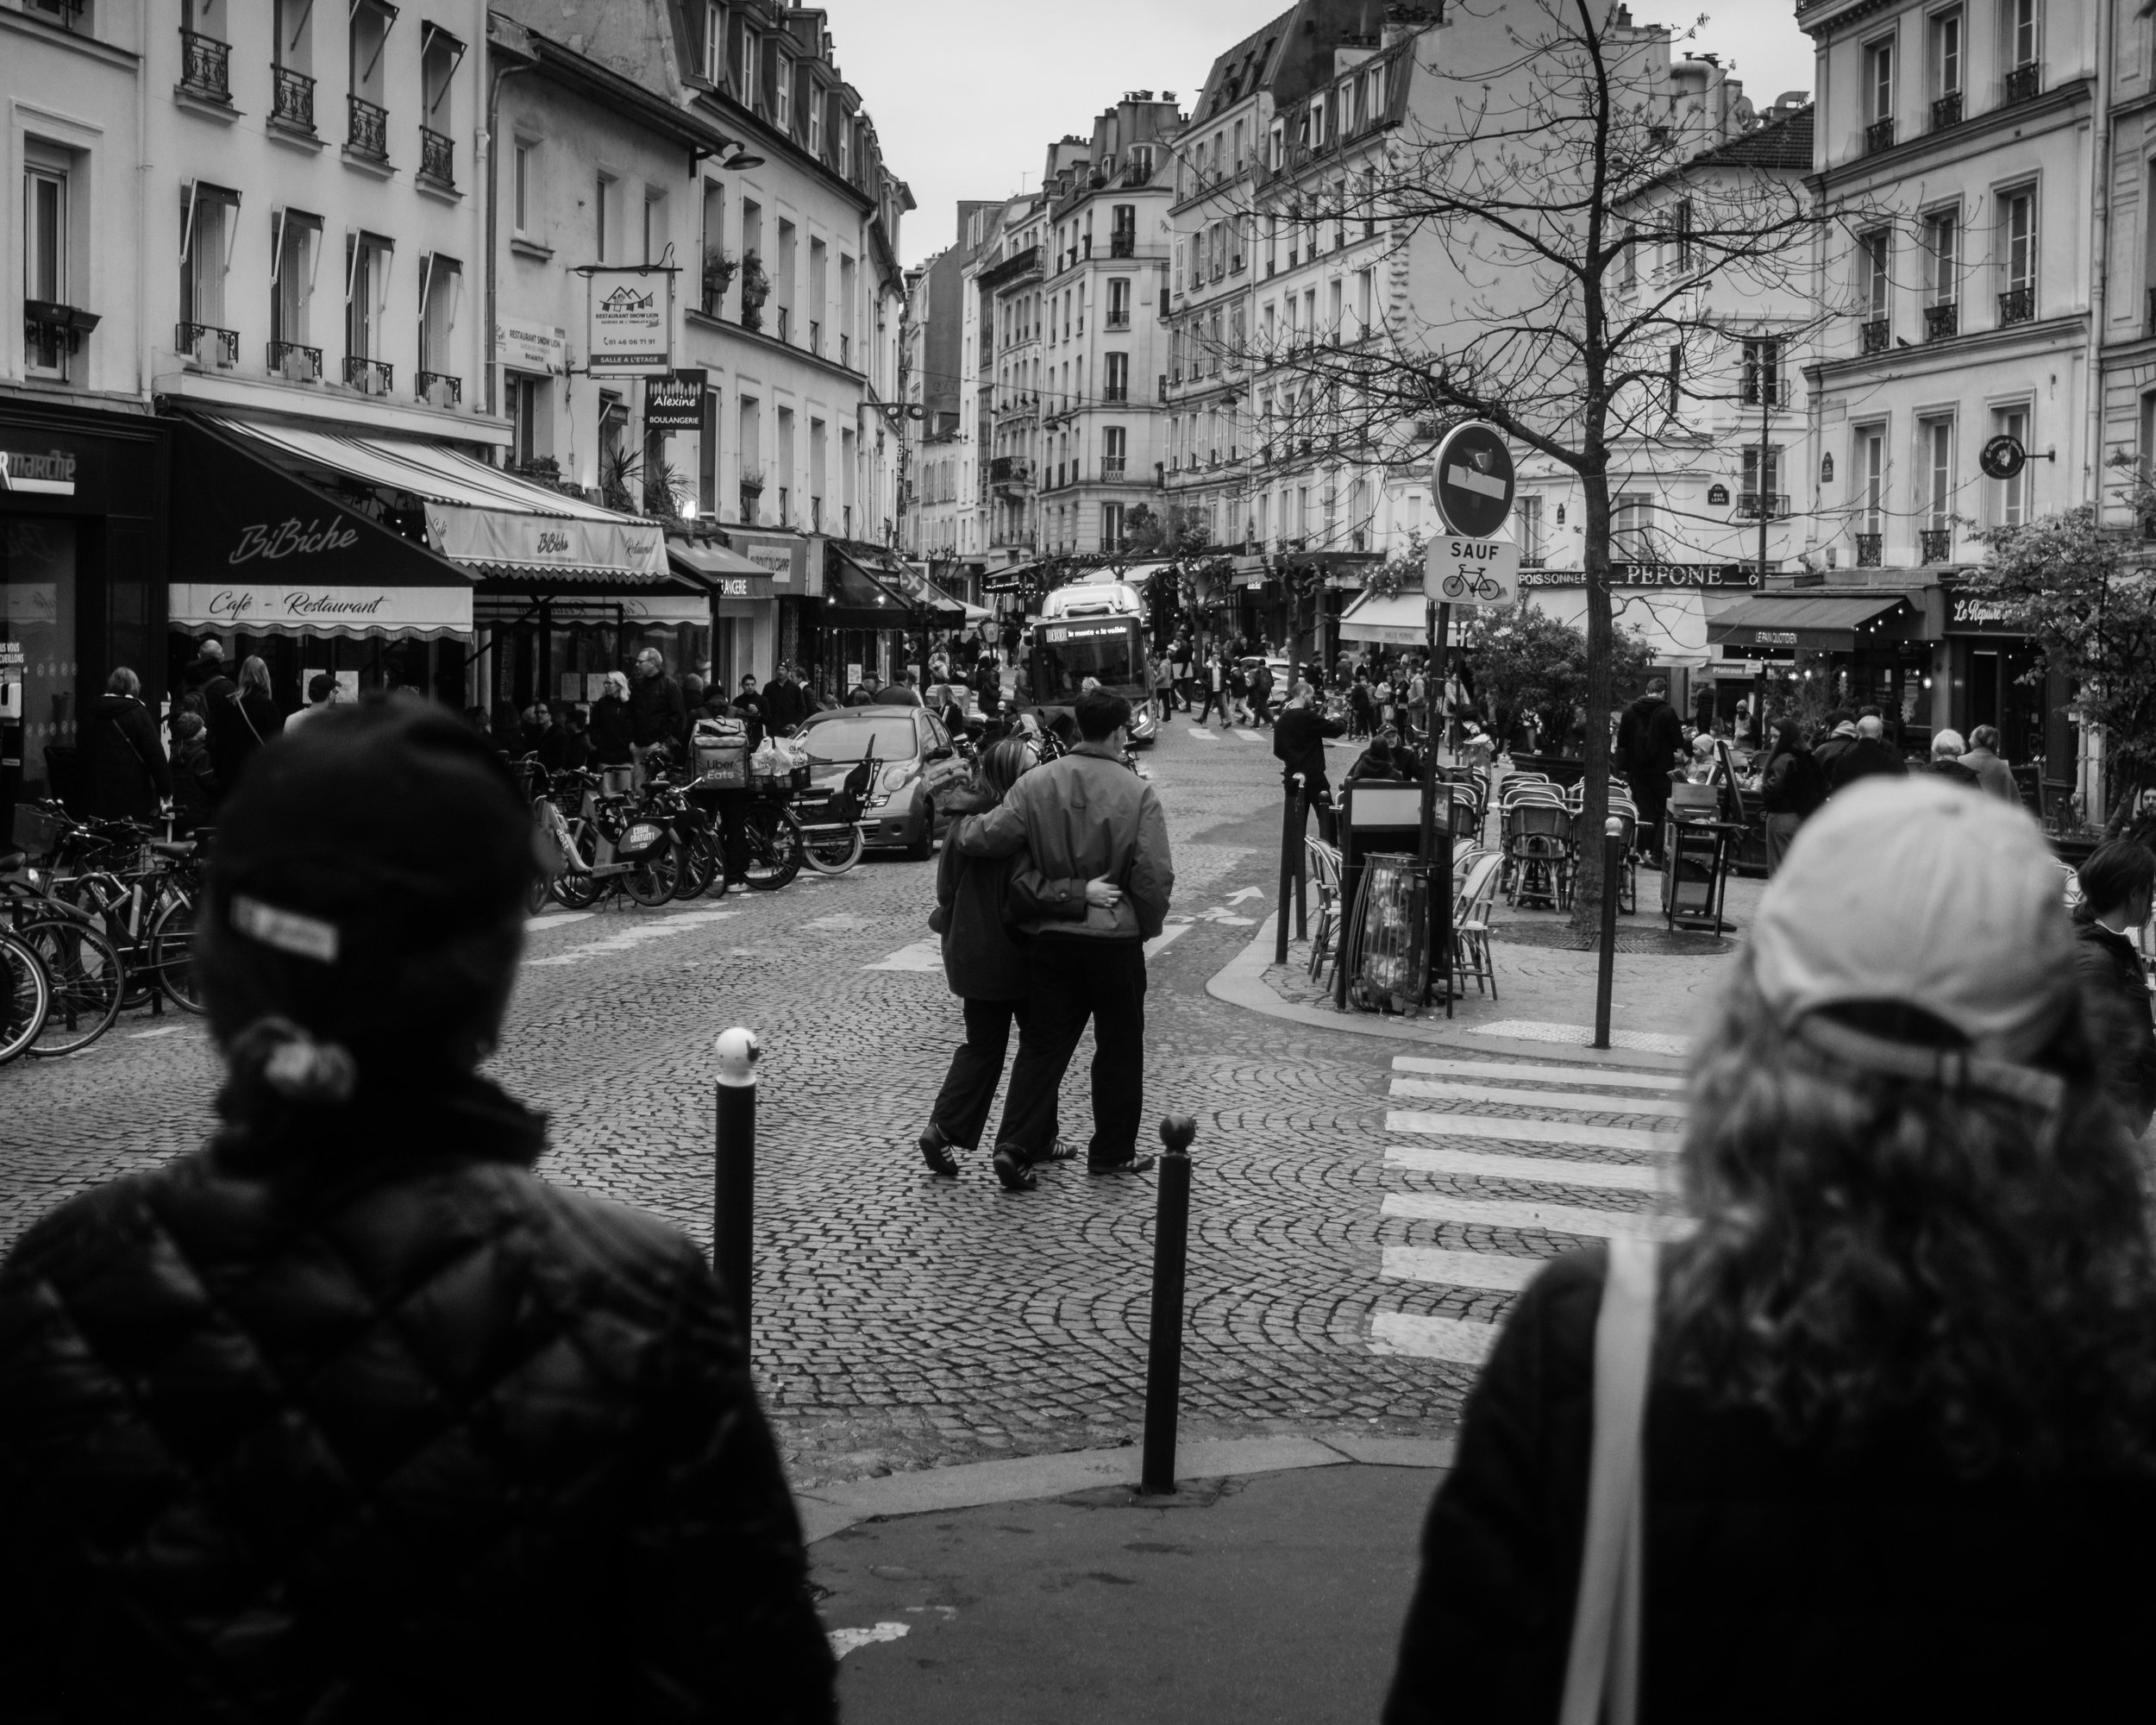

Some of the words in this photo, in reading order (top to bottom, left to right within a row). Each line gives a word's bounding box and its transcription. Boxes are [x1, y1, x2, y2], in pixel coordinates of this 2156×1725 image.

[509, 329, 536, 343] RESTAURANT
[537, 335, 550, 346] SNOW
[654, 395, 696, 407] Alexine
[649, 416, 699, 424] BOULANGERIE
[229, 515, 359, 564] BiBiche
[1451, 542, 1499, 561] SAUF
[1626, 566, 1723, 586] PEPONE
[209, 591, 253, 620] Café
[284, 592, 391, 616] Restaurant
[1953, 599, 1967, 621] Le
[1049, 630, 1065, 641] 40
[1756, 631, 1762, 643] LE
[1762, 631, 1772, 643] PAIN
[1773, 632, 1797, 644] QUOTIDIEN
[7, 643, 20, 652] VOUS
[1713, 666, 1744, 674] Plateaux
[707, 760, 735, 770] Uber
[707, 770, 735, 780] Eats
[633, 825, 649, 836] ESSAI
